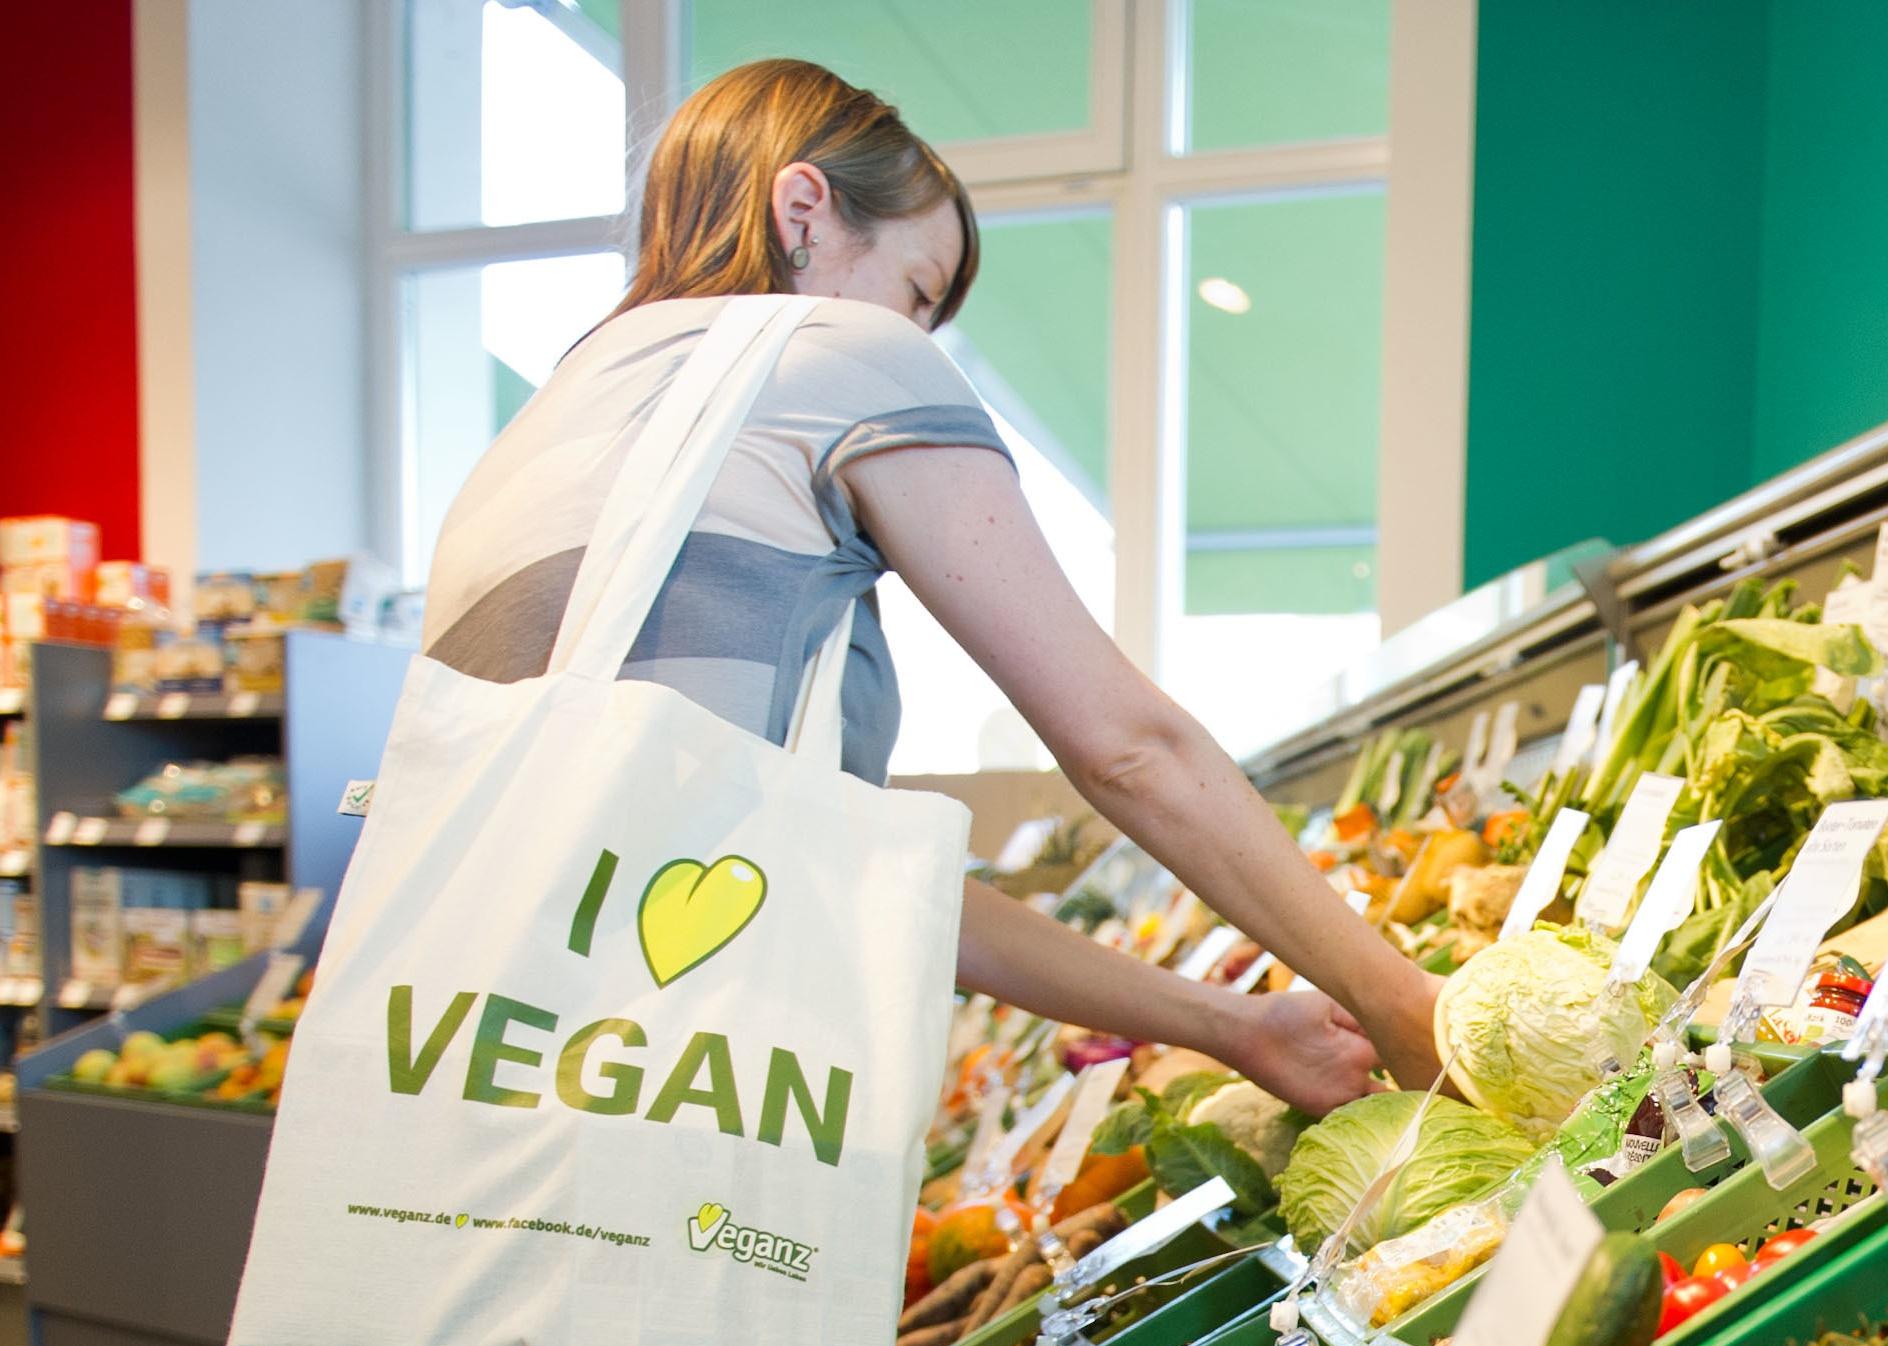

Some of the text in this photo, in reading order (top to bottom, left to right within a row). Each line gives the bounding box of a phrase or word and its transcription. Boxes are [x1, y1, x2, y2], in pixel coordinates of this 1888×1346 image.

[567, 848, 619, 957] I
[387, 984, 853, 1168] VEGAN
[347, 1202, 651, 1247] www.veganz.de www.facebook.de/veganz
[688, 1206, 813, 1273] Veganz
